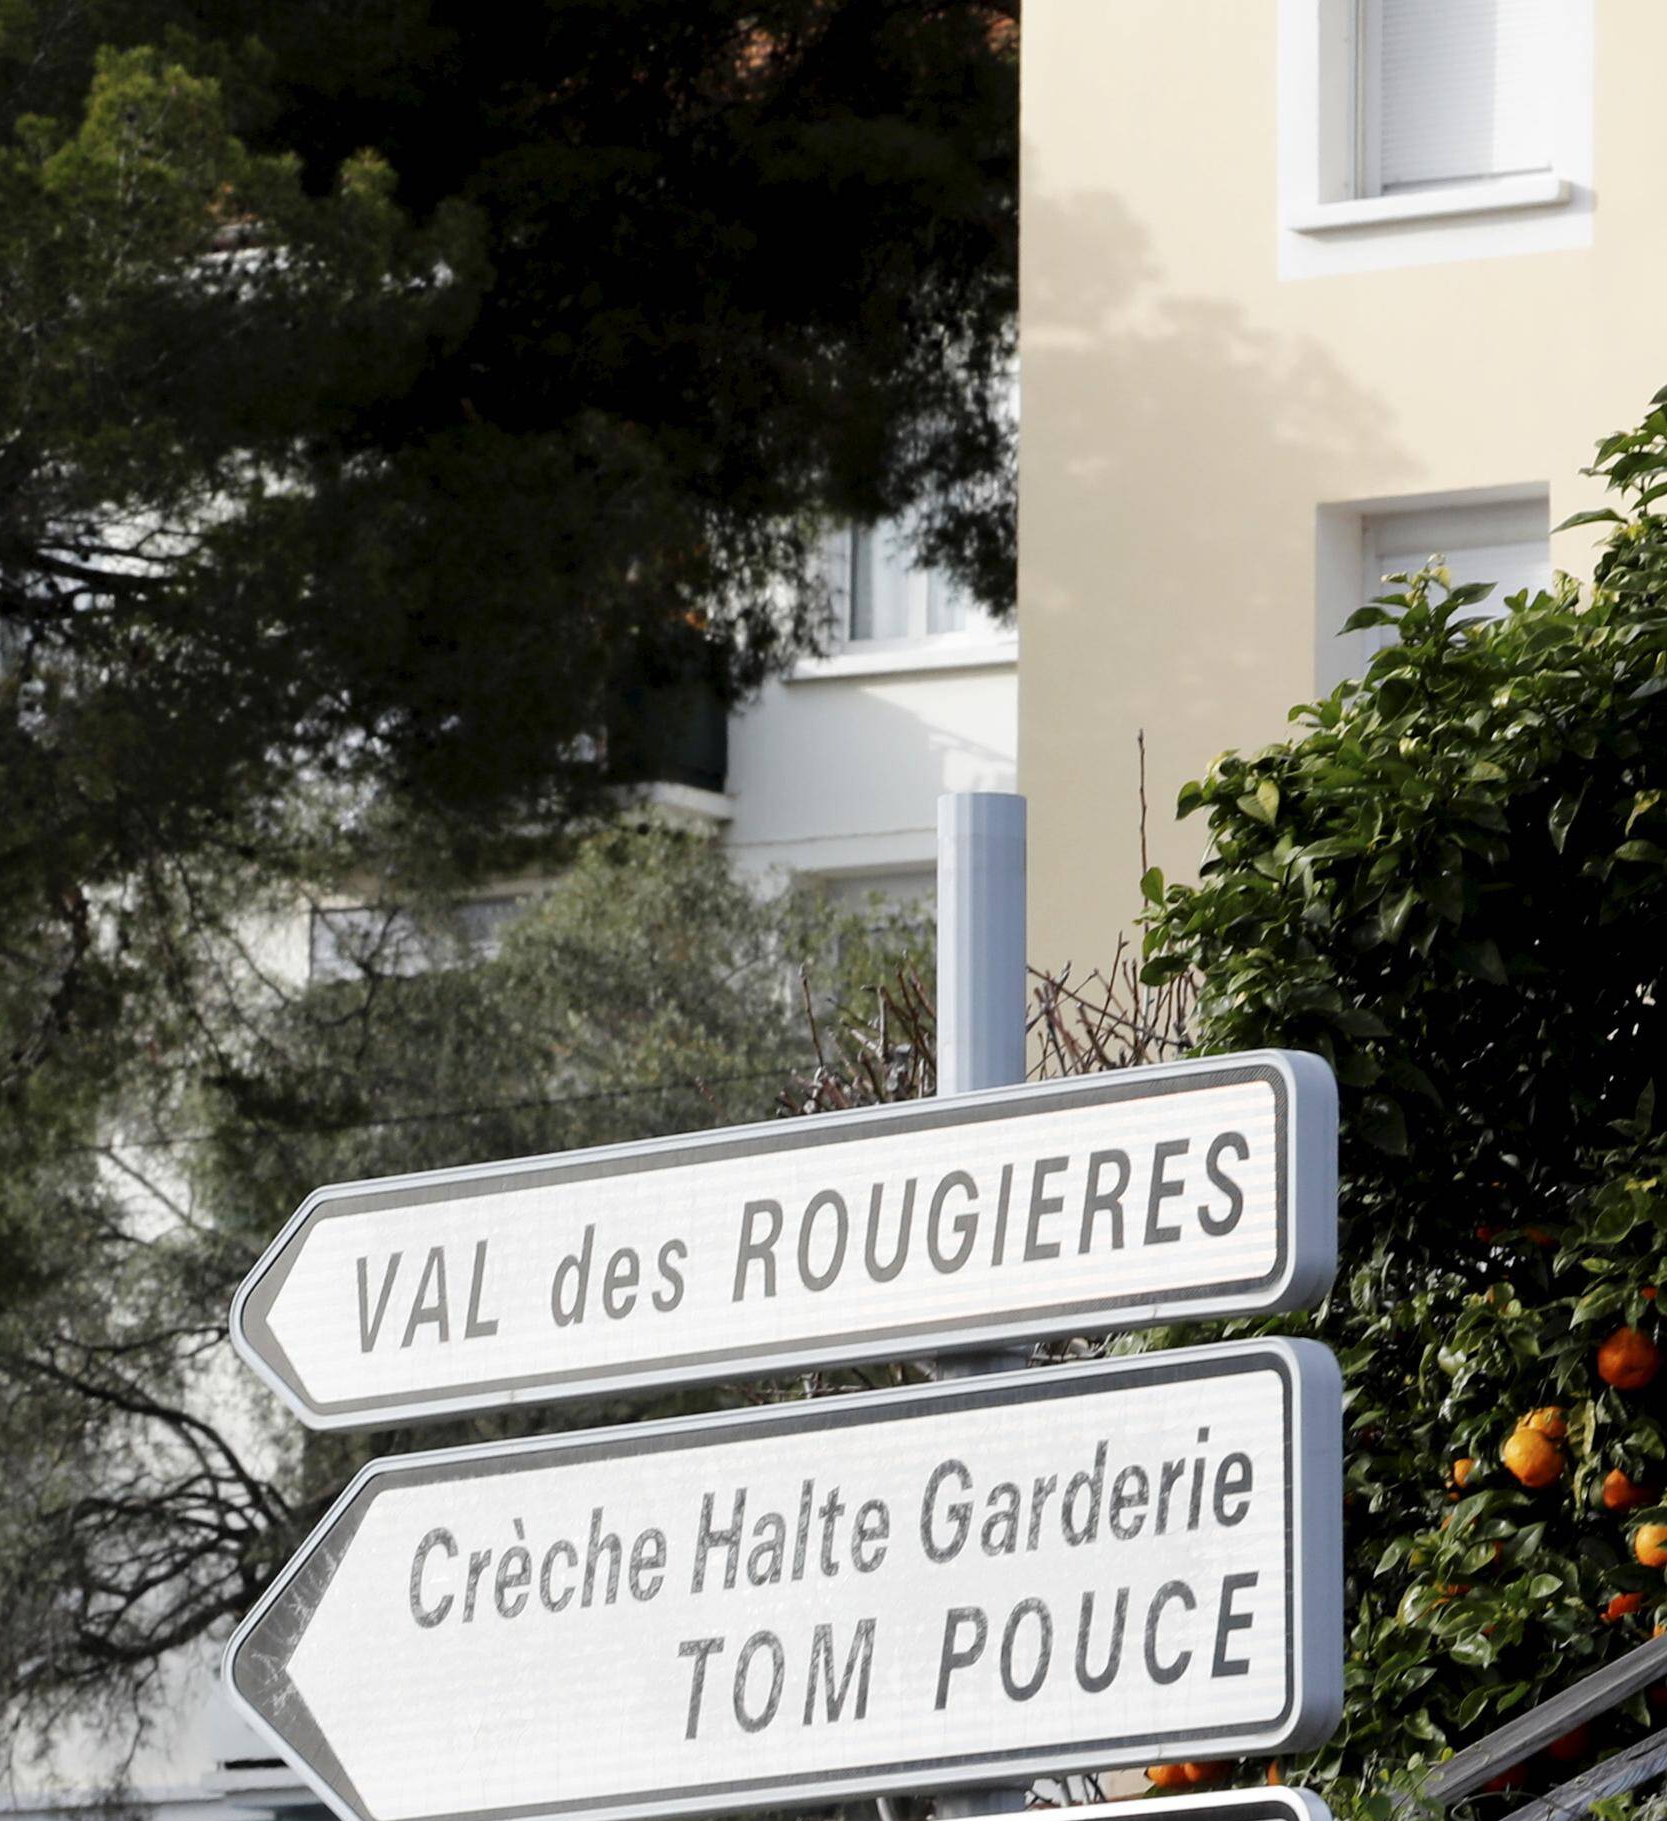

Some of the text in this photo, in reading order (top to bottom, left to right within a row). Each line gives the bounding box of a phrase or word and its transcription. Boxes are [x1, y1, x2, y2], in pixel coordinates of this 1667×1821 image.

[354, 1130, 1251, 1354] VAL des ROUGIERES
[407, 1426, 1254, 1630] Crèche Halte Garderie
[678, 1572, 1259, 1739] TOM POUCE
